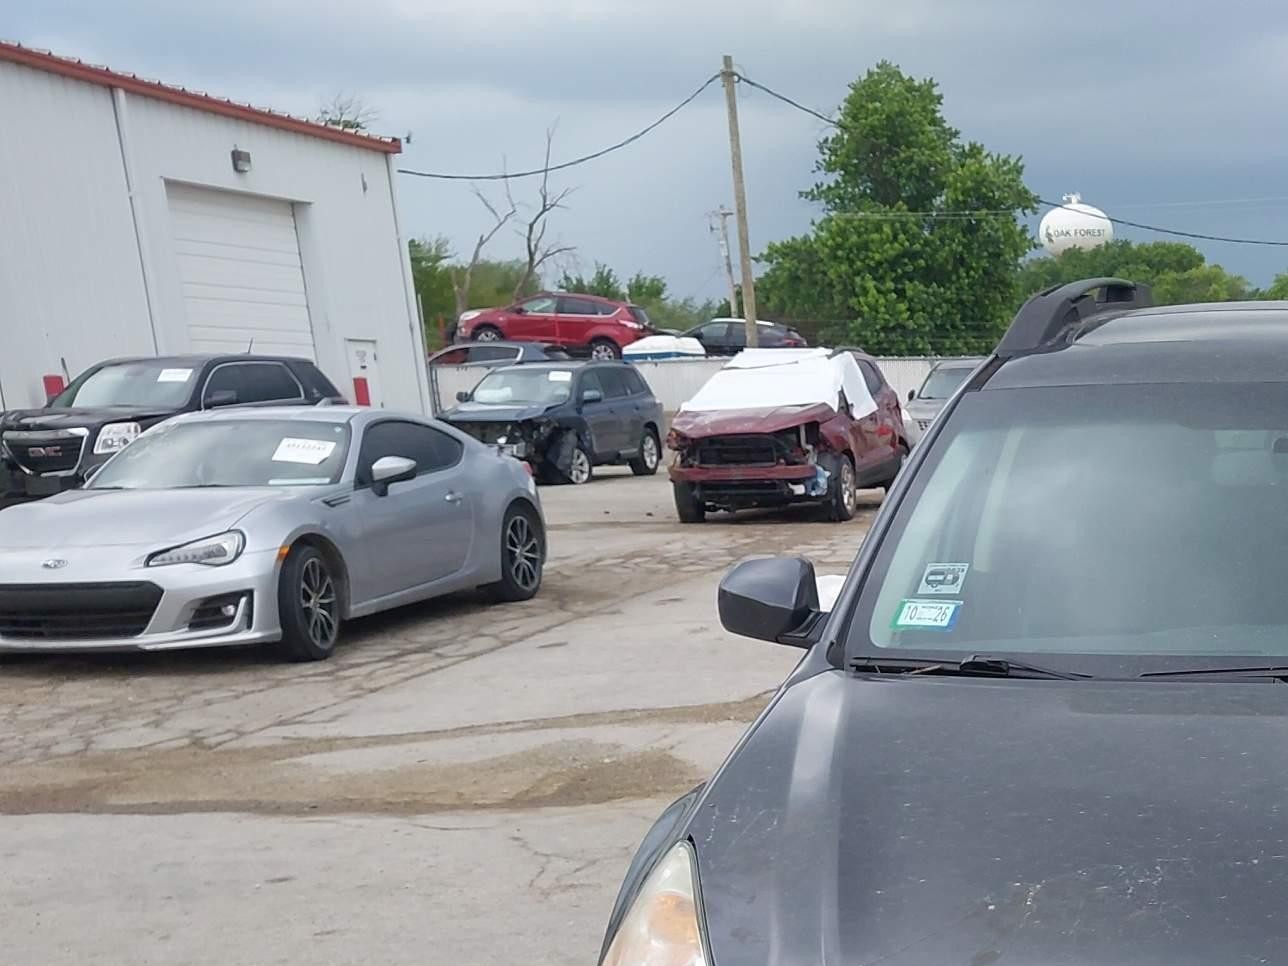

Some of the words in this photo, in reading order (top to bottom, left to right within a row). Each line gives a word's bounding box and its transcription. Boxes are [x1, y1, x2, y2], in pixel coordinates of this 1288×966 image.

[1054, 229, 1071, 237] OAK
[1074, 229, 1105, 237] FOREST
[904, 604, 919, 621] 10
[933, 605, 950, 622] 26
